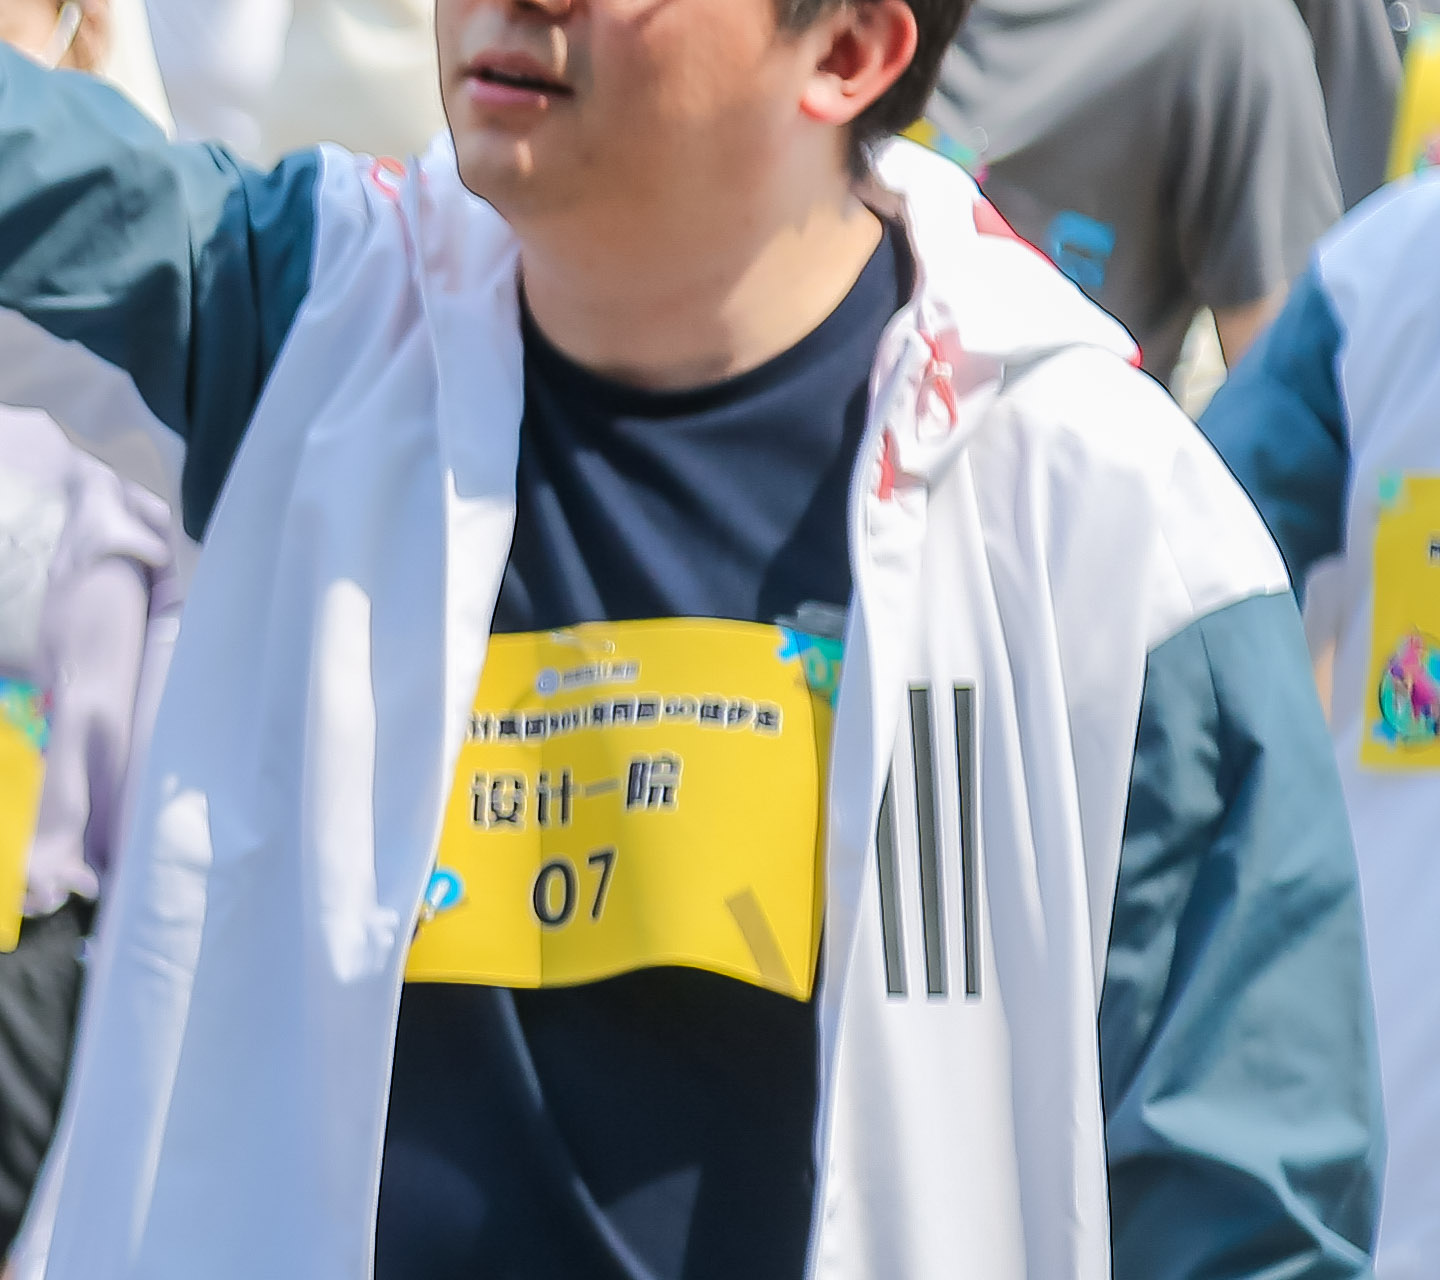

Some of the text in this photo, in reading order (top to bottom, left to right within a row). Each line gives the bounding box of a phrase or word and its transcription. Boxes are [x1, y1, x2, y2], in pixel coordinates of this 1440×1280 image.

[472, 754, 682, 826] 设计一院
[532, 848, 618, 926] 07
